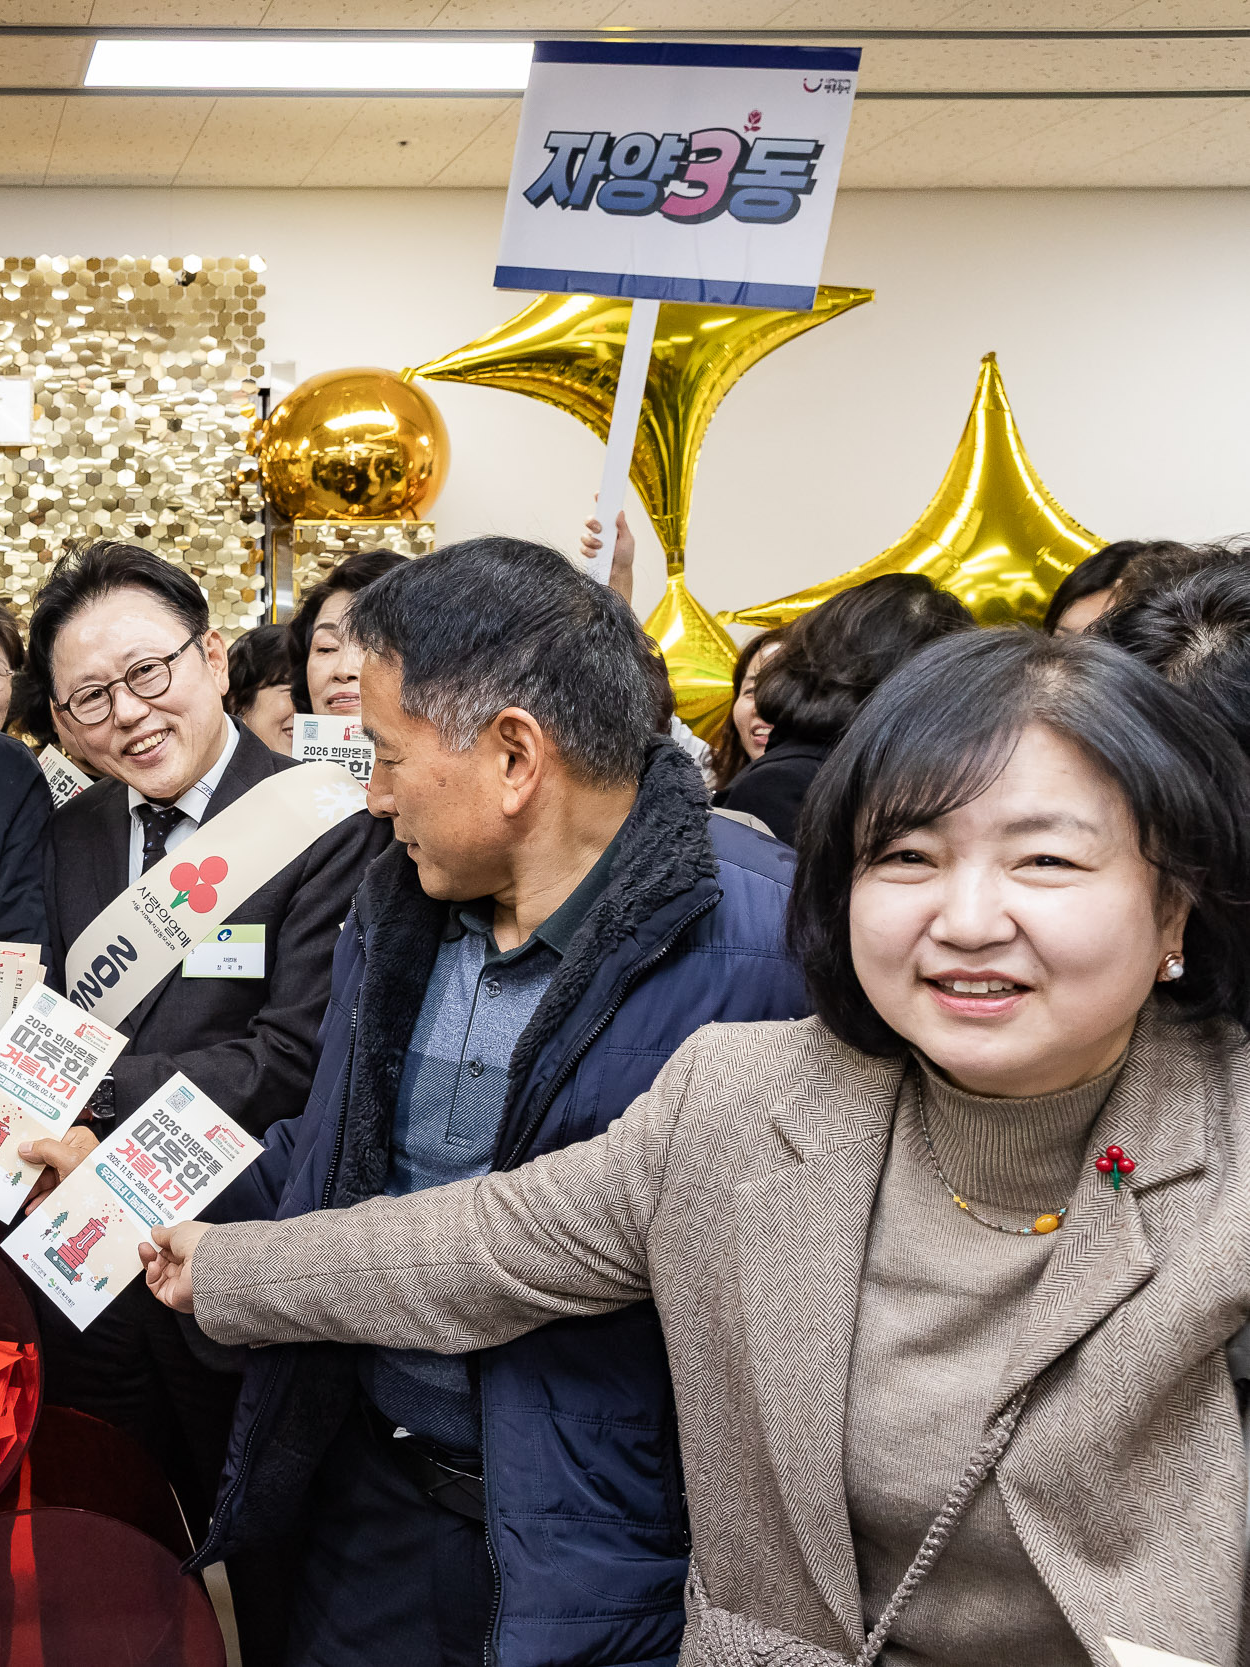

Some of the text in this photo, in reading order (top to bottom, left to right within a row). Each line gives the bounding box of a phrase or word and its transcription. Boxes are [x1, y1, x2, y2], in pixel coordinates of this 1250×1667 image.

[523, 127, 825, 224] 자양3동
[303, 746, 372, 759] 2026 희망온돌
[137, 886, 192, 948] 사랑의열매
[0, 1044, 77, 1101] 겨울나기
[10, 1024, 90, 1086] 따뜻한
[25, 1015, 54, 1038] 2026
[52, 1033, 98, 1068] 희망온돌
[131, 1118, 211, 1196] 따뜻한
[153, 1109, 182, 1136] 2026
[177, 1133, 224, 1177] 희망온돌
[115, 1138, 190, 1211] 겨울나기
